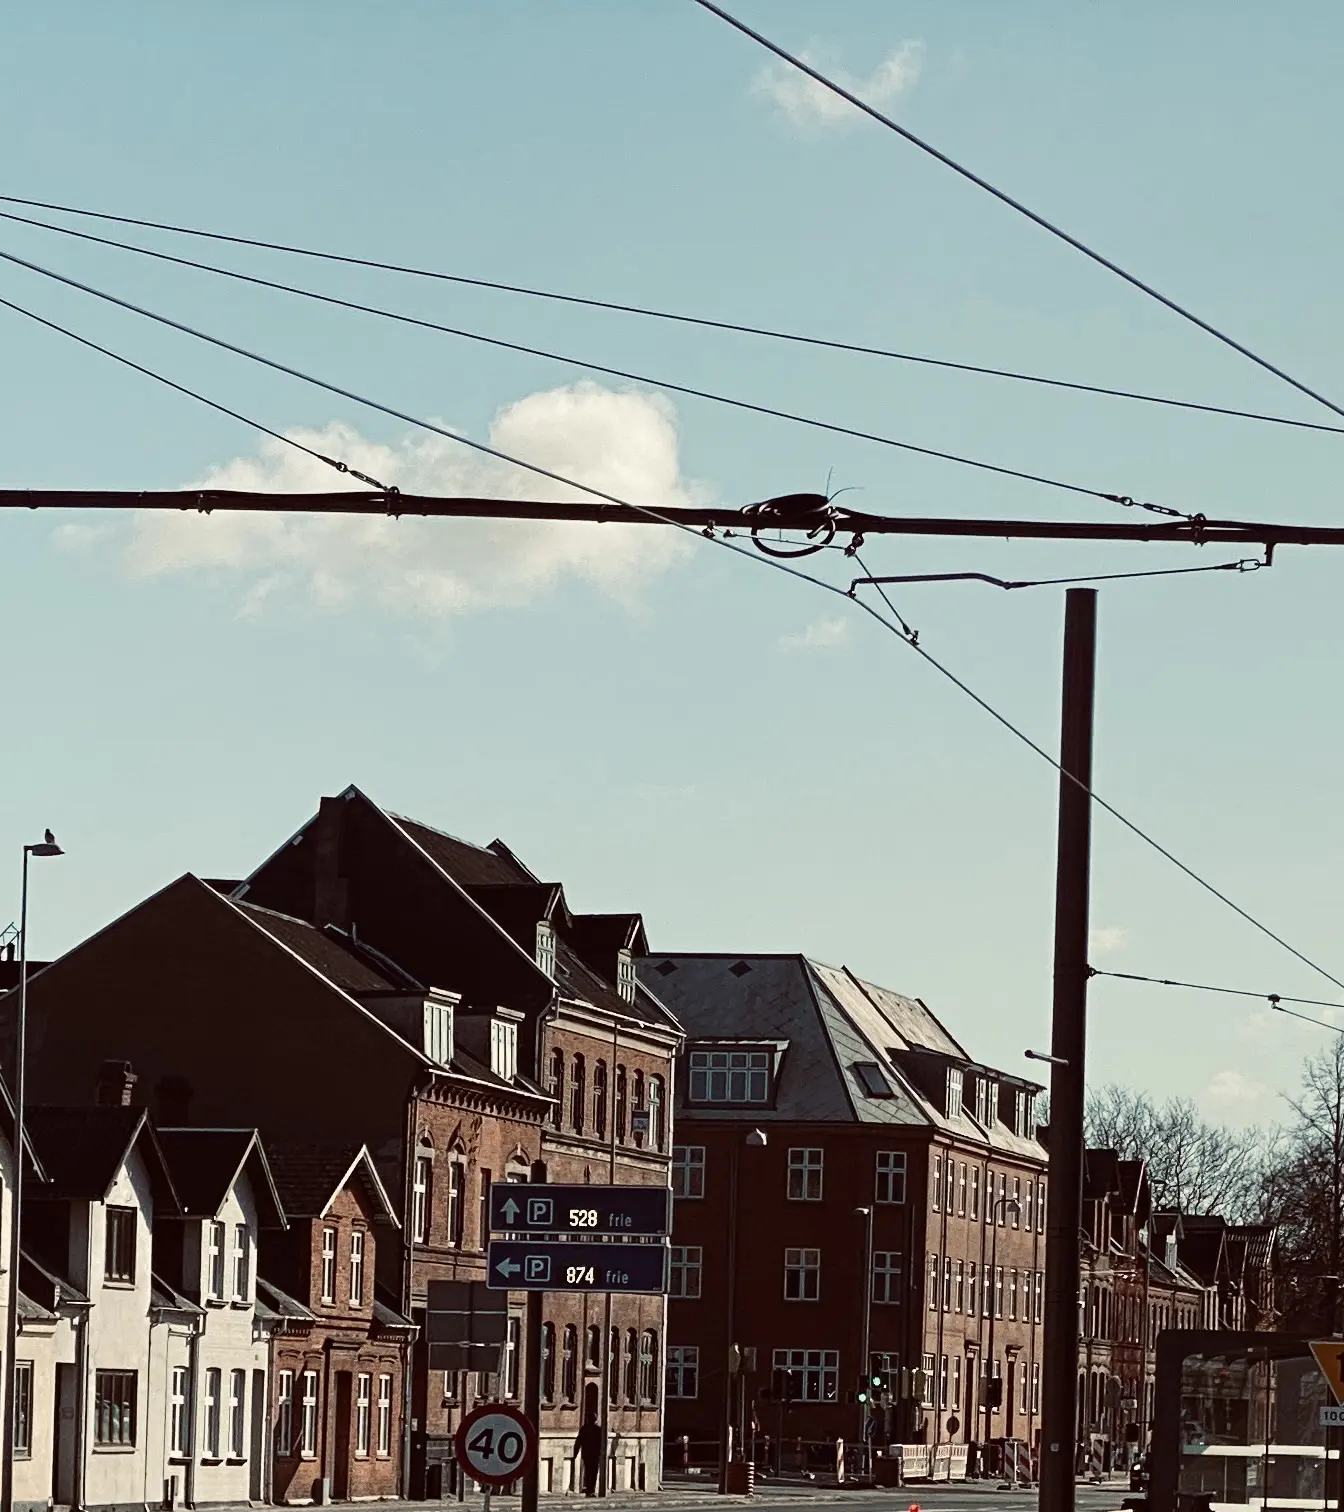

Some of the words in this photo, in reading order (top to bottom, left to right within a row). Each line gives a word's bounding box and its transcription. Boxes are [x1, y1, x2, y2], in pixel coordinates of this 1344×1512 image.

[533, 1203, 547, 1221] P
[569, 1209, 598, 1227] 528
[609, 1213, 632, 1227] frie
[530, 1259, 545, 1278] P
[566, 1266, 595, 1284] 874
[606, 1270, 629, 1284] frie
[467, 1427, 524, 1464] 40
